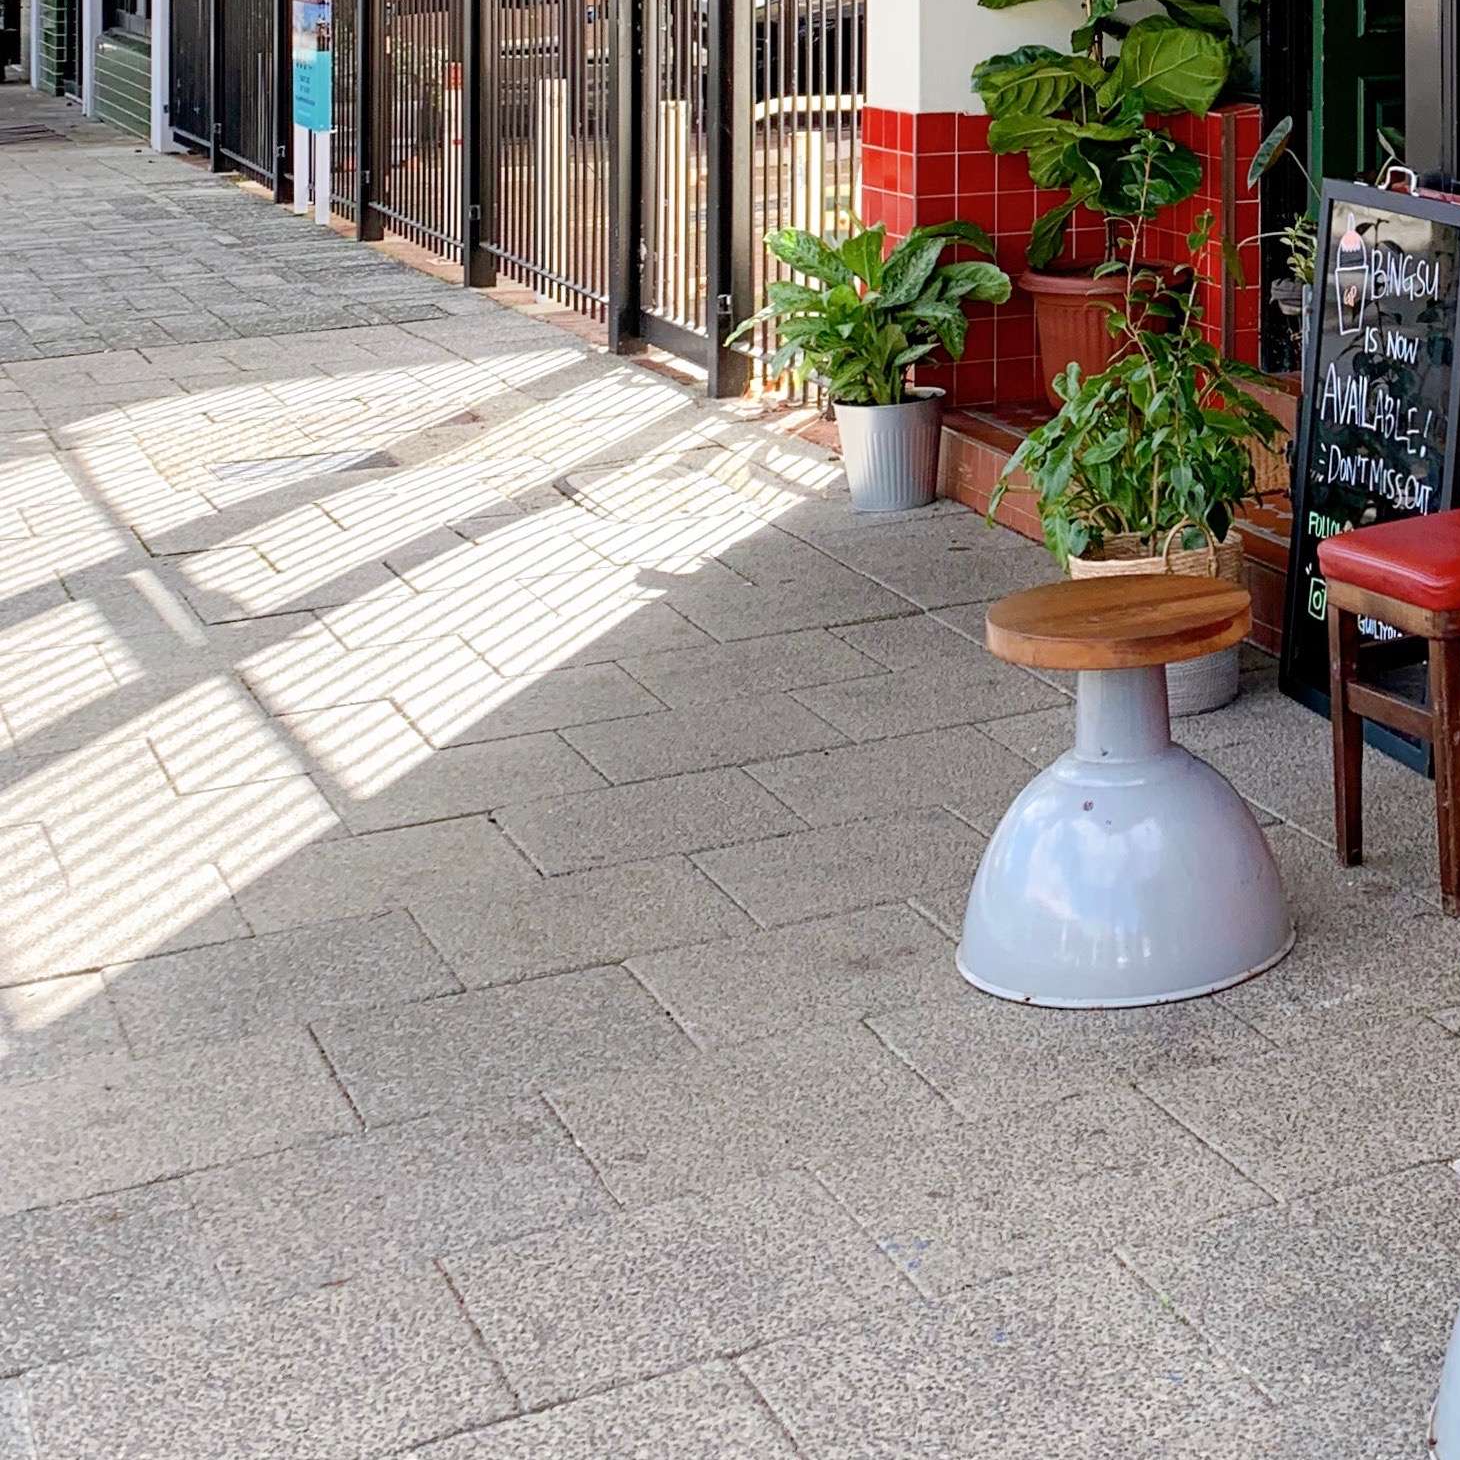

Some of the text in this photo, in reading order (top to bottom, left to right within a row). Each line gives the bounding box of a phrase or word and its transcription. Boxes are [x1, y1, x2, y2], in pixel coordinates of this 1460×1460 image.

[1370, 248, 1440, 302] BINGSU
[1364, 326, 1419, 364] IS NOW
[1327, 444, 1433, 516] DON'T MISS OUT
